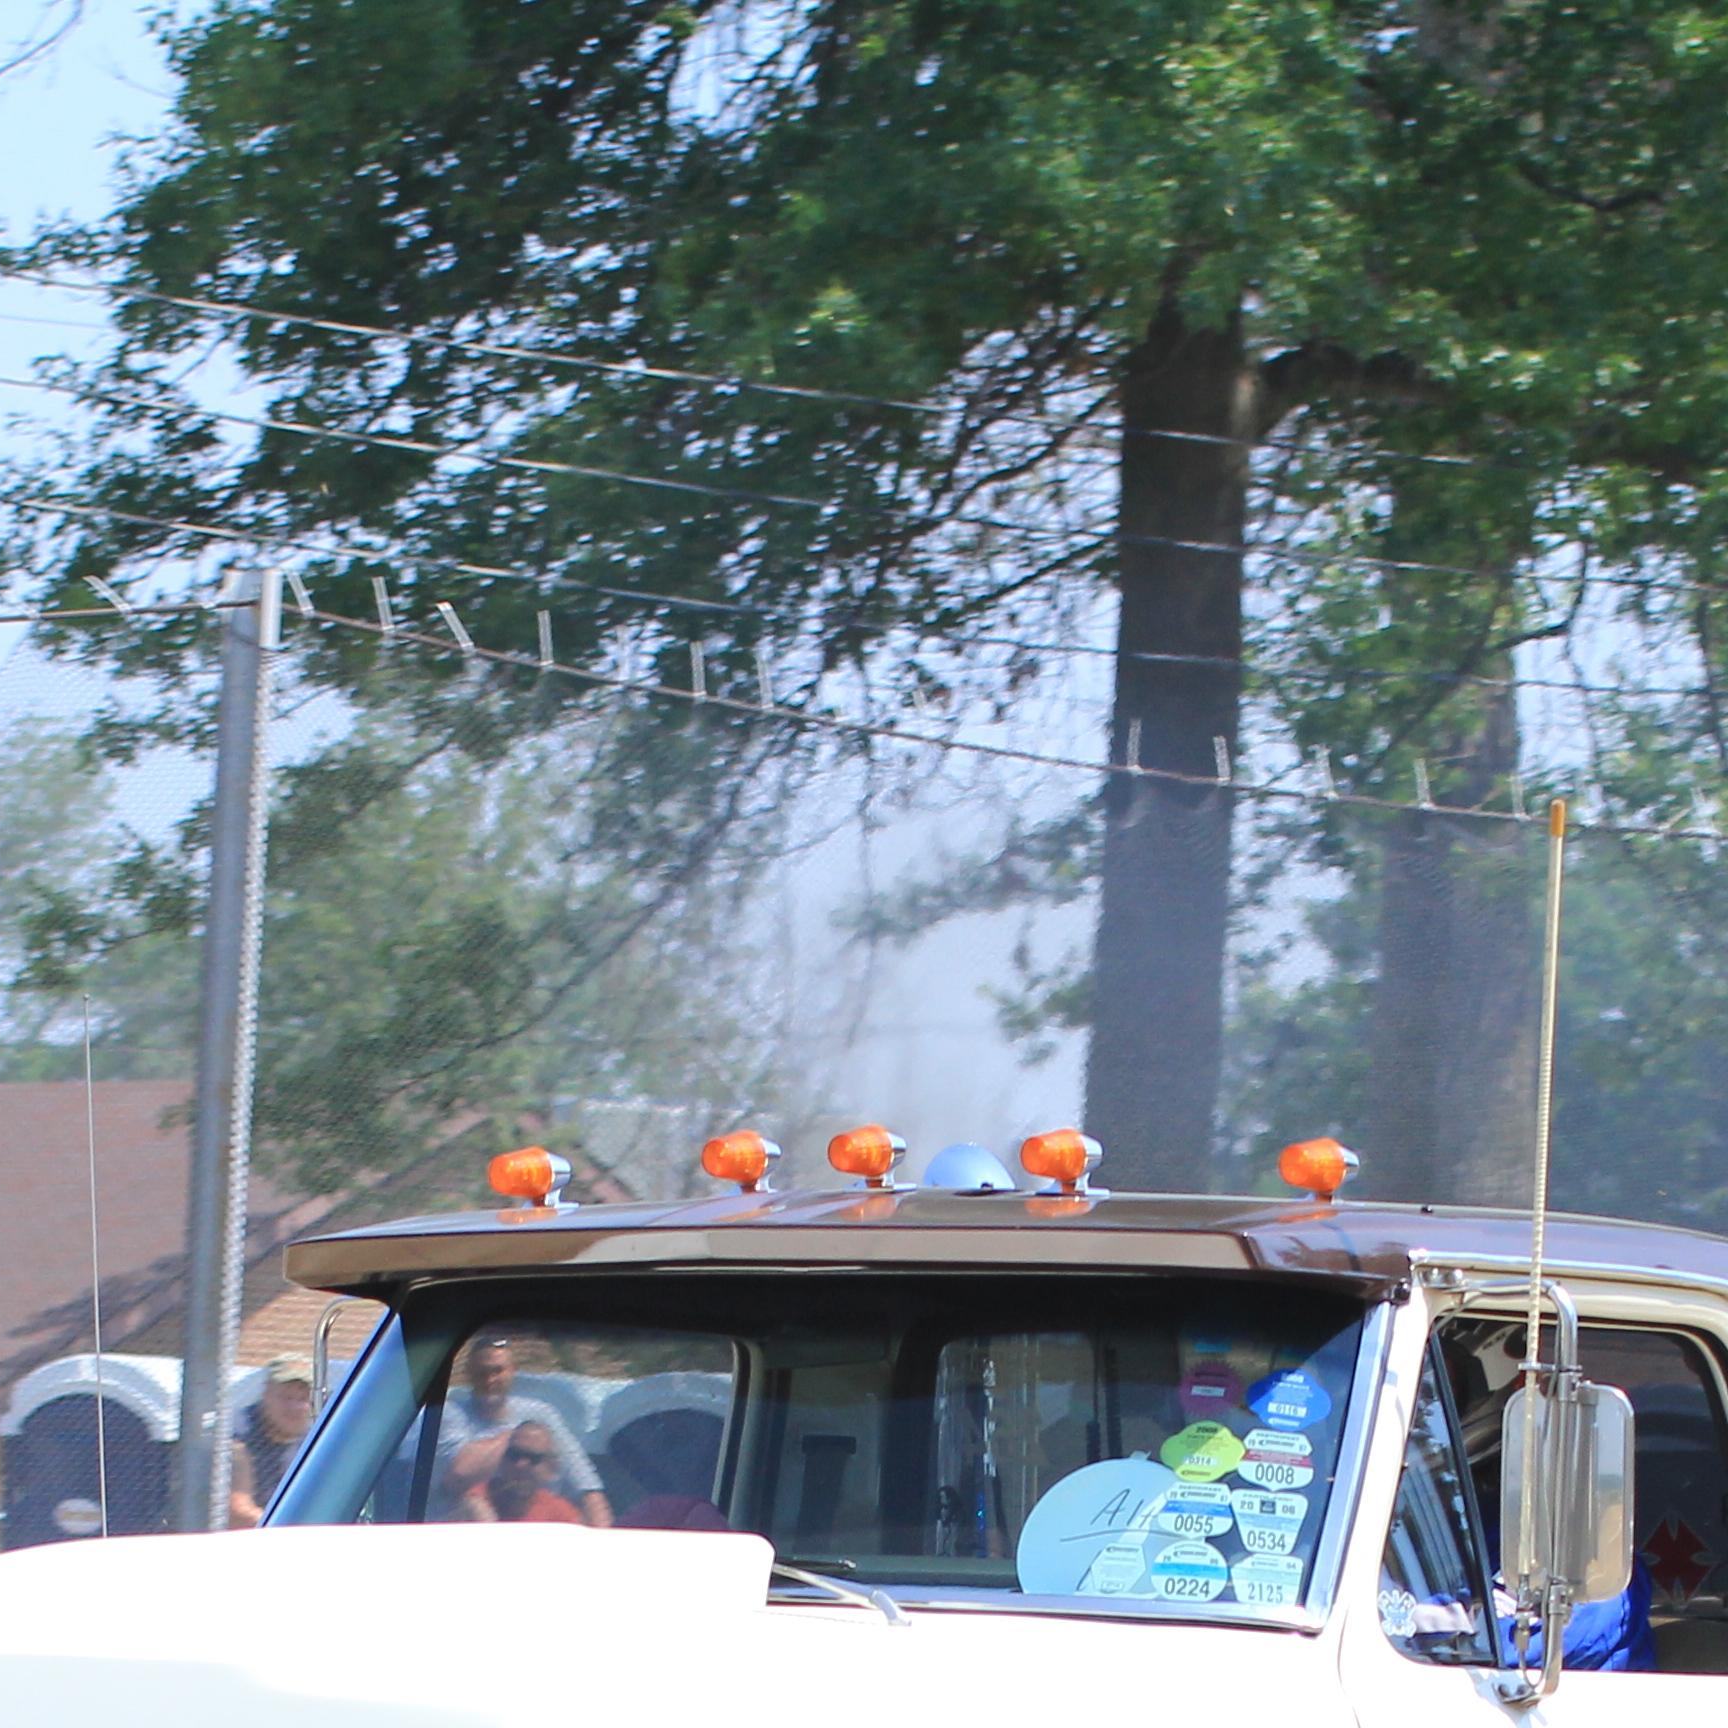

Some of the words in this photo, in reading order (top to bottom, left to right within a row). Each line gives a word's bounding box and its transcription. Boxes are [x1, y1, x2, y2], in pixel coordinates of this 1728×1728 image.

[1254, 1462, 1295, 1486] 0008
[1239, 1500, 1255, 1511] 20
[1173, 1513, 1215, 1535] 0055
[1246, 1529, 1287, 1553] 0534
[1163, 1576, 1211, 1598] 0224
[1247, 1581, 1284, 1605] 2125
